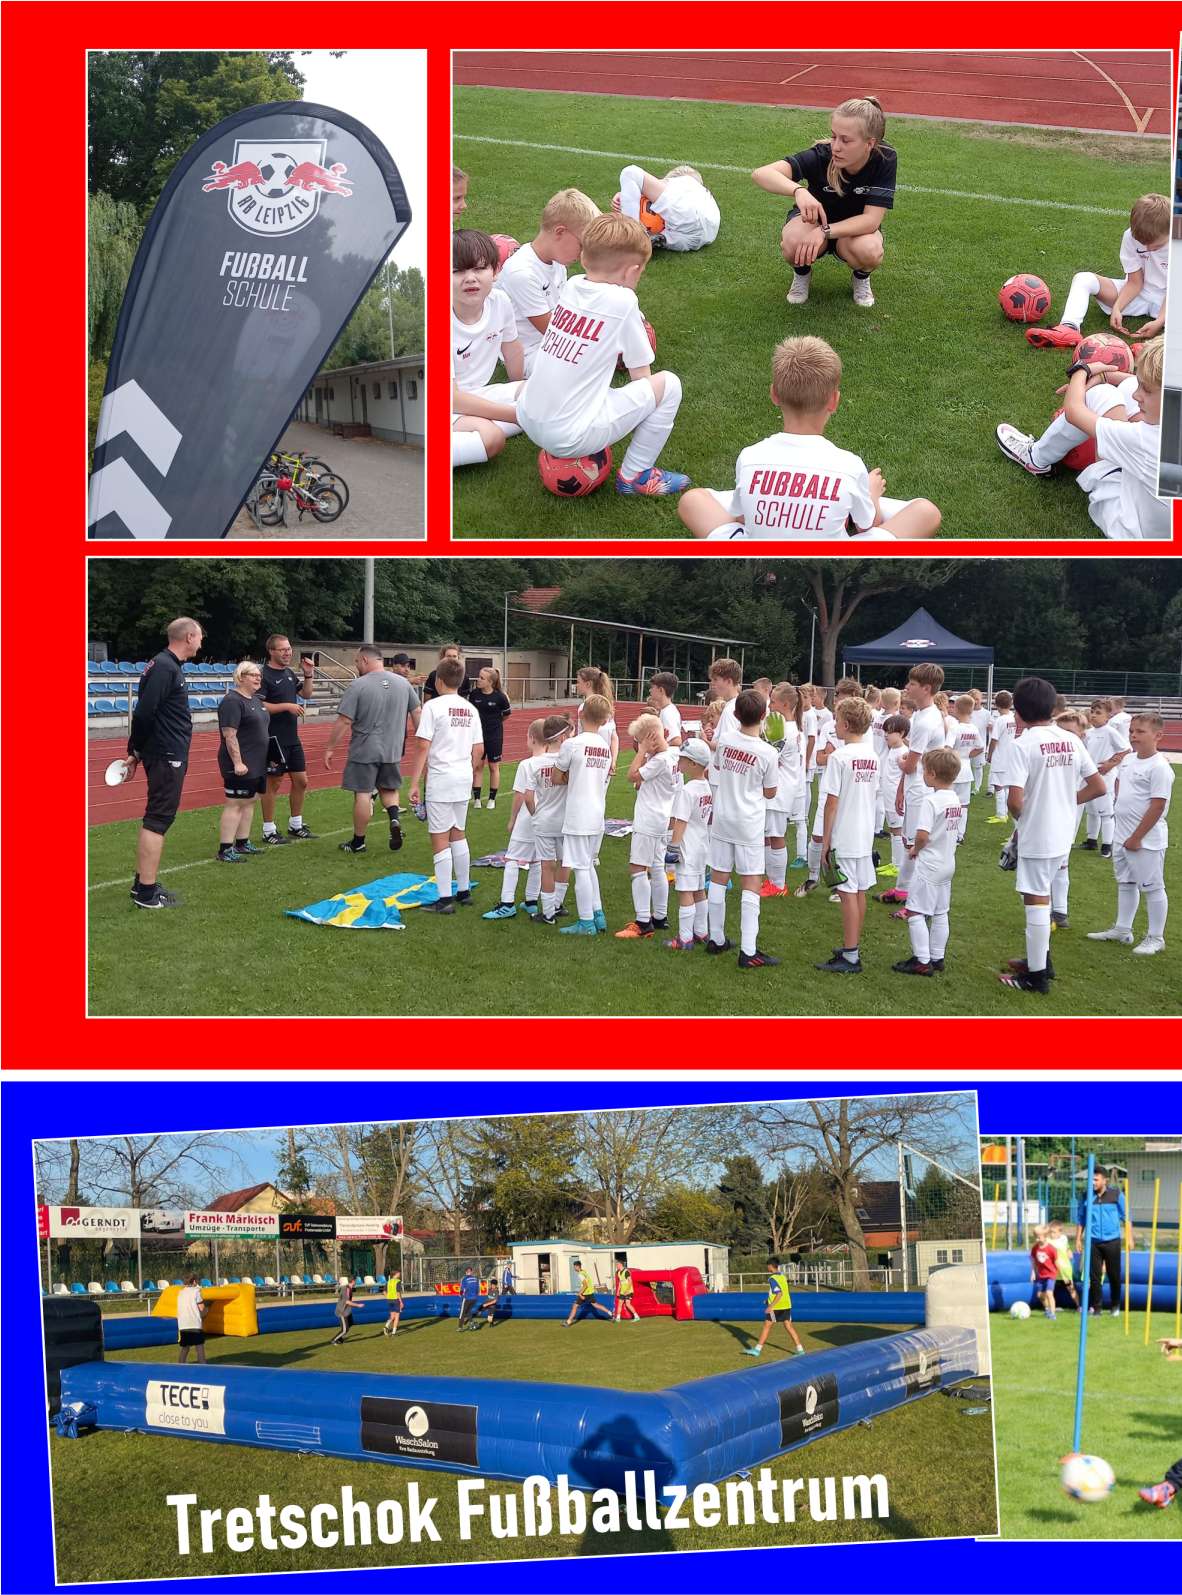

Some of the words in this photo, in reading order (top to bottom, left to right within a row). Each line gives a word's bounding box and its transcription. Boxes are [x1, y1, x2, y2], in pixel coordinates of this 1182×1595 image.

[237, 195, 257, 214] RB
[254, 195, 310, 225] LEIPZIG
[219, 251, 309, 282] FUßBALL
[223, 280, 296, 311] SCHULE
[749, 470, 842, 502] FUßBALL
[754, 500, 829, 531] SCHULE
[82, 1218, 126, 1227] GERNDT
[189, 1213, 223, 1224] Frank
[226, 1214, 275, 1225] Märkisch
[160, 1384, 201, 1409] TECE
[158, 1412, 179, 1425] close
[181, 1416, 190, 1425] to
[192, 1417, 209, 1430] you
[395, 1435, 439, 1449] WaschSalon
